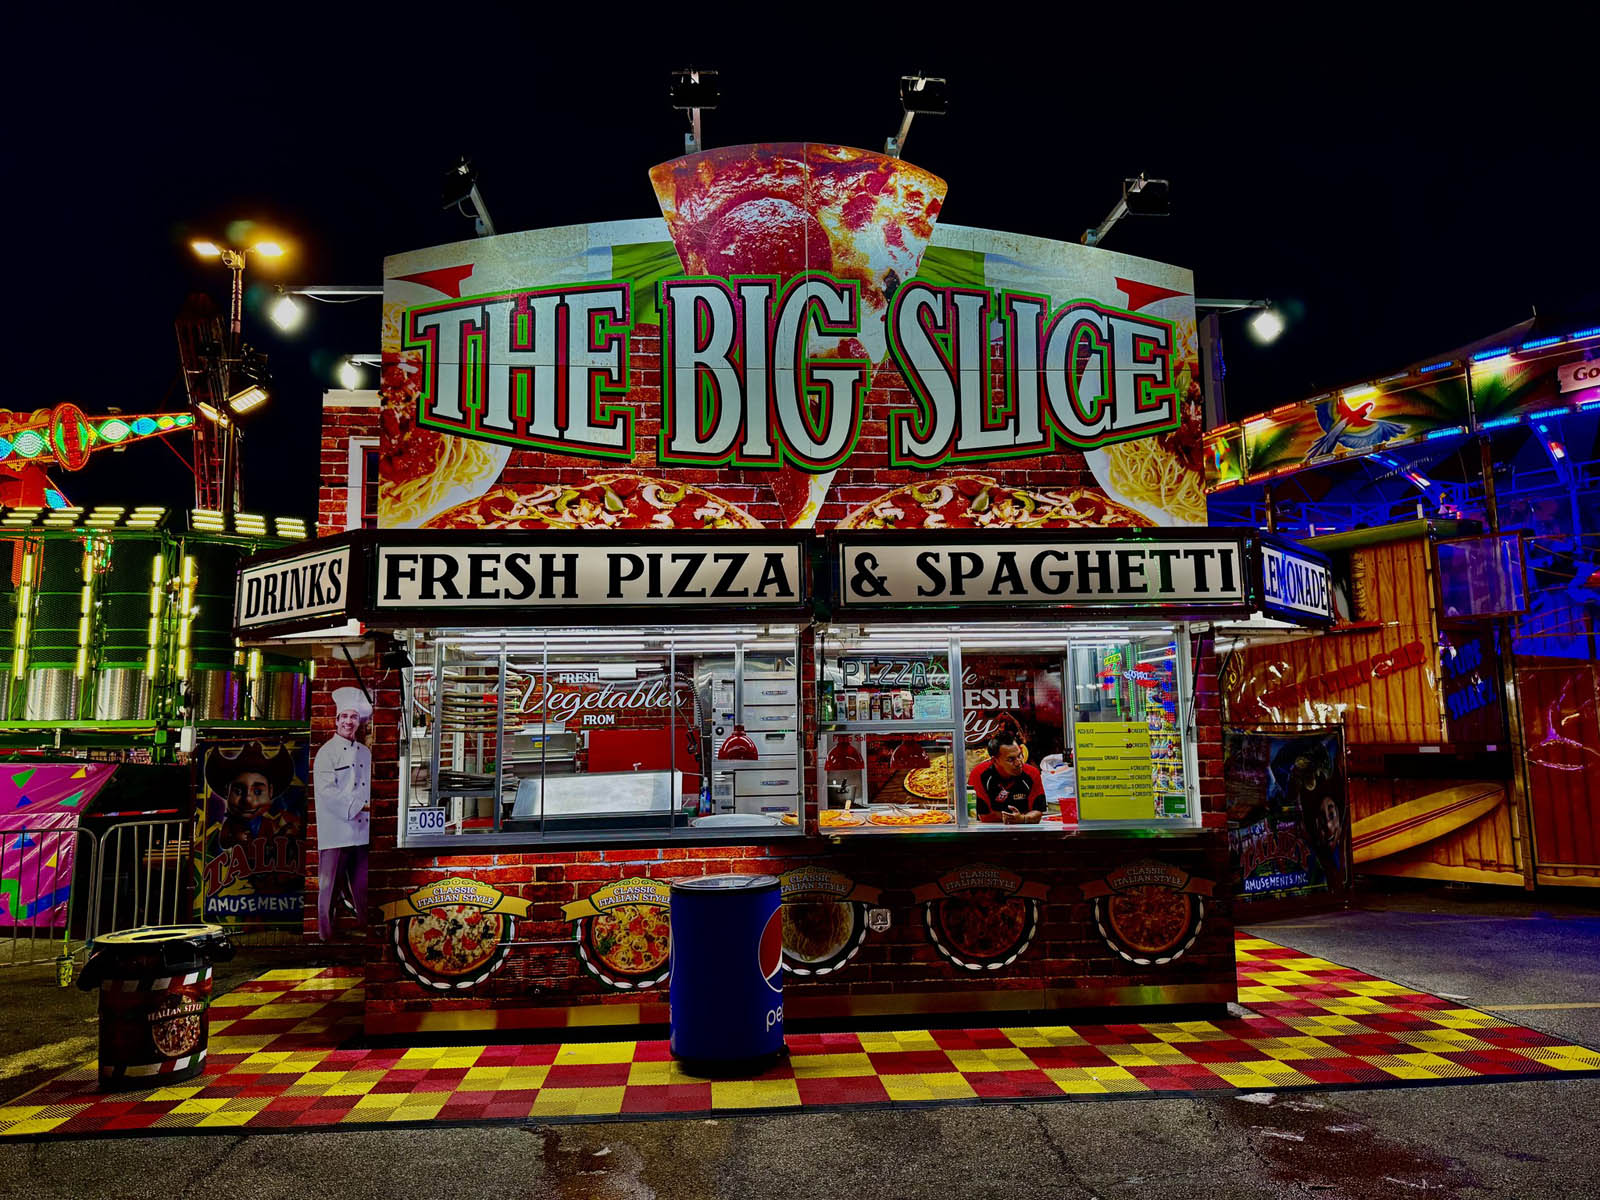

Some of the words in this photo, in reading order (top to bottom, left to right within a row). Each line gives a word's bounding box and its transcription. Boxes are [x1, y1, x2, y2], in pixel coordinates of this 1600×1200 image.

[410, 283, 630, 453] THE
[665, 277, 863, 464] BIG
[896, 284, 1174, 461] SLICE
[384, 552, 579, 600] FRESH
[606, 552, 795, 600] PIZZA
[850, 551, 891, 598] &
[916, 549, 1238, 597] SPAGHETTI
[1262, 547, 1328, 612] LEMONADE
[244, 558, 343, 619] DRINKS
[558, 672, 600, 684] FRESH
[842, 660, 928, 687] PIZZA
[518, 673, 688, 723] Vegetables
[963, 688, 1020, 710] ESH
[583, 714, 616, 725] FROM
[420, 811, 444, 828] 036
[788, 873, 831, 884] CLASSIC
[1126, 865, 1167, 877] CLASSIC
[432, 885, 477, 896] CLASSIC
[613, 885, 657, 896] CLASSIC
[780, 882, 815, 894] TALIAN
[817, 881, 848, 893] STYLE
[206, 896, 305, 913] AMUSEMENTS
[417, 893, 459, 907] ITALIAN
[461, 892, 494, 906] STYLE
[598, 893, 640, 907] ITALIAN
[147, 1006, 183, 1021] ITALIAN
